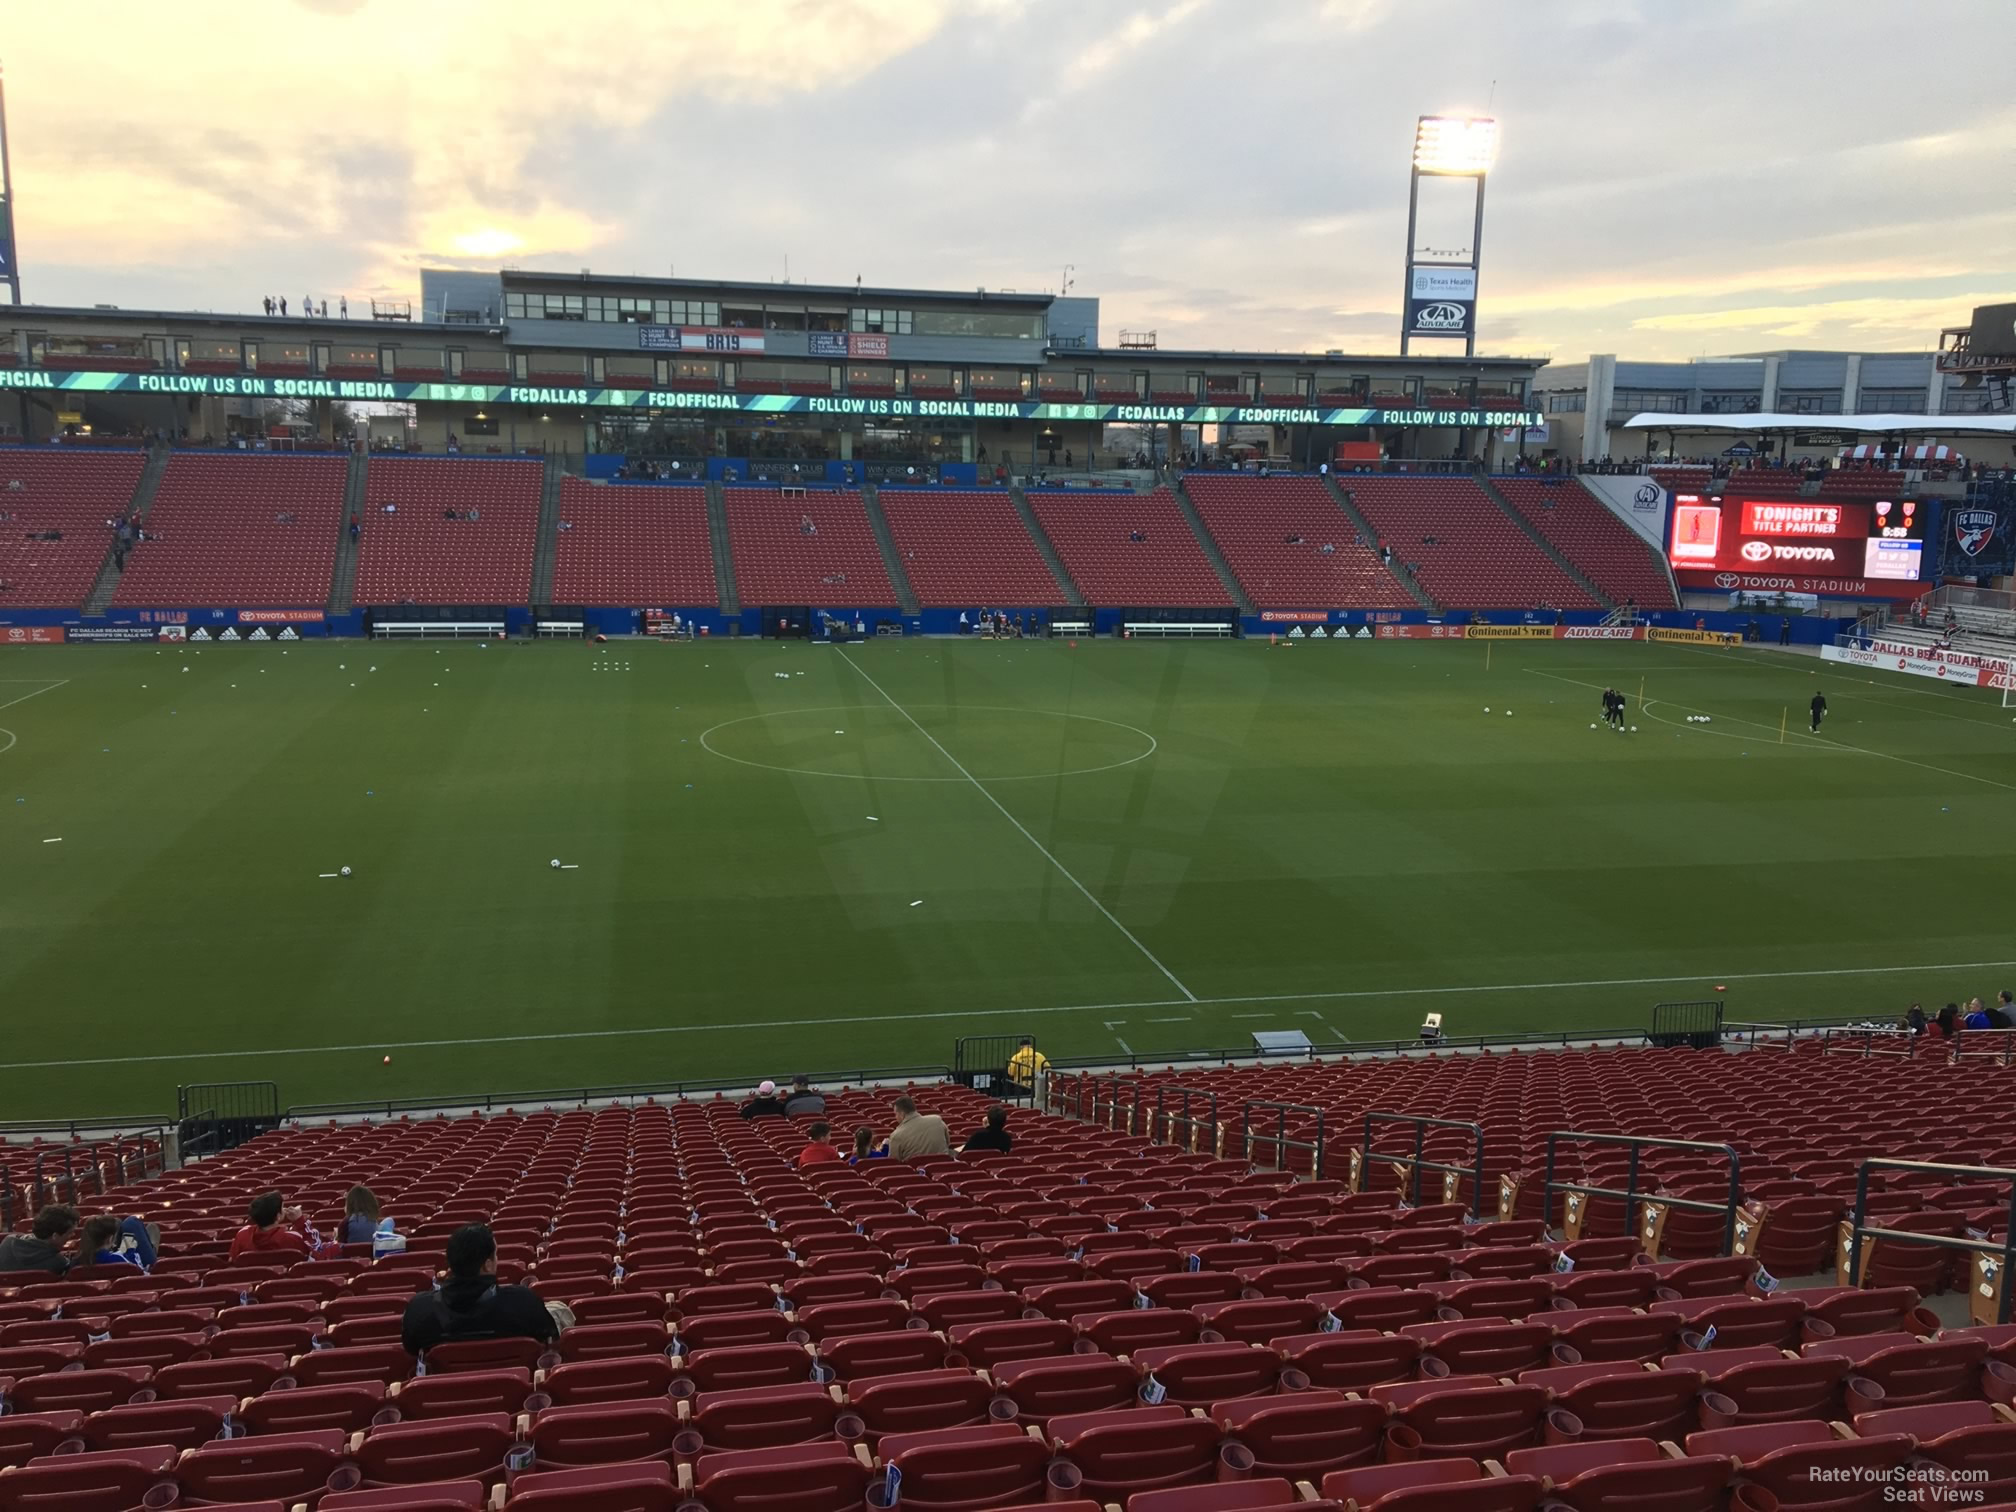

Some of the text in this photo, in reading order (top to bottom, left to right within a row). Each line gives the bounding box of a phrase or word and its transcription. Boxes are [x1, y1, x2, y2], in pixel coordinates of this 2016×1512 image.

[1430, 277, 1448, 285] Texas
[1417, 320, 1464, 328] ADVOCARE
[706, 334, 740, 351] BR19
[139, 375, 394, 398] FOLLOW US ON SOCIAL MEDIA
[510, 387, 588, 404] FCDALLAS
[648, 392, 740, 409] FCDOFFICIAL
[809, 398, 1019, 416] FOLLOW US ON SOCIAL MEDIA
[1118, 406, 1184, 420] FCDALLAS
[1239, 408, 1320, 423] FCDOFFICIAL
[1383, 410, 1435, 424] FOLLOW
[1440, 411, 1457, 425] US
[1461, 411, 1479, 425] ON
[1485, 412, 1532, 425] SOCIAL
[750, 463, 823, 472] WINNERS CLUB
[1754, 506, 1837, 522] TONIGHT'S
[1959, 513, 1993, 525] FC DALLAS
[1753, 521, 1836, 534] TITLE PARTNER
[1878, 516, 1912, 527] 0 0
[1773, 546, 1835, 561] TOYOTA
[1743, 577, 1866, 592] TOYOTA STADIUM
[289, 612, 324, 620] STADIUM
[1468, 626, 1521, 637] Continental
[1564, 627, 1633, 639] ADVOCARE
[1648, 628, 1704, 641] Continental
[1849, 650, 1878, 662] TOYOTA
[1873, 642, 1914, 657] DALLAS
[1907, 662, 1936, 672] MoneyGram
[1947, 669, 1977, 678] MoneyGram
